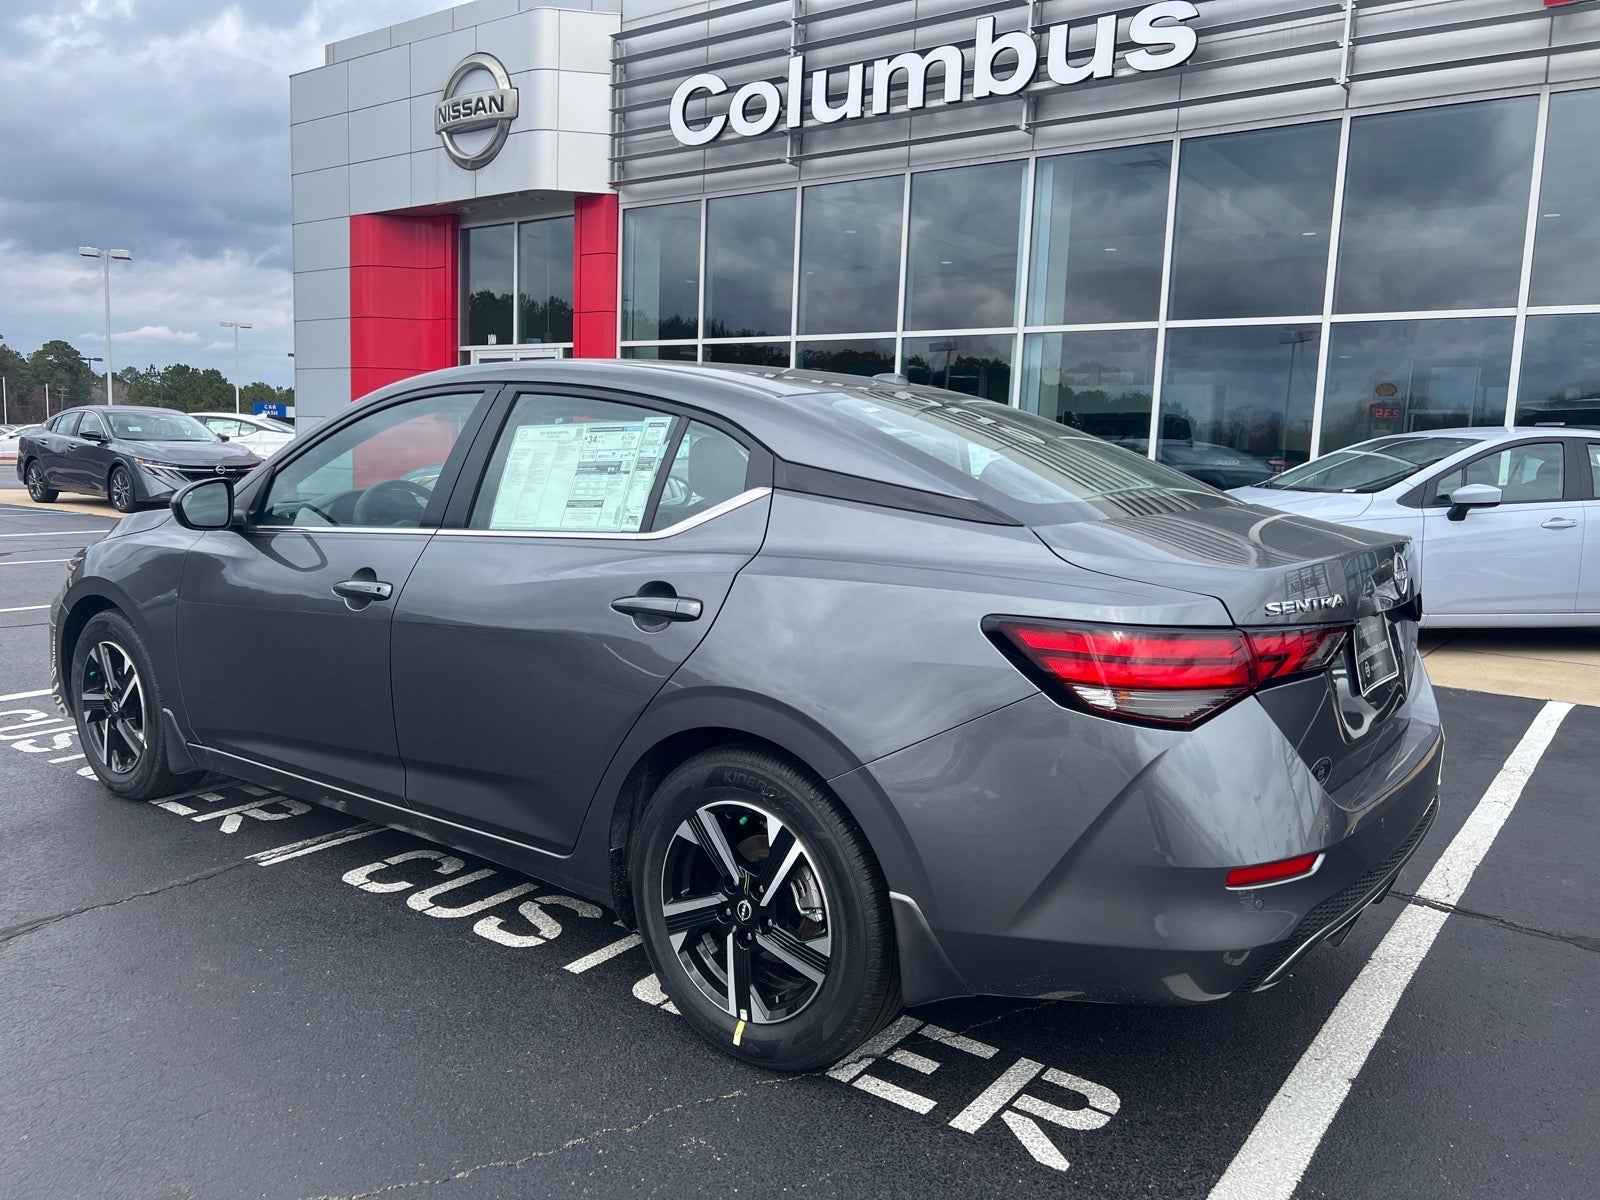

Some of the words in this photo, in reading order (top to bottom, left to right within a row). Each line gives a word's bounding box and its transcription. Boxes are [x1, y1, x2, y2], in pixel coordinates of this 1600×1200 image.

[669, 1, 1199, 146] Columbus
[438, 95, 504, 125] NISSAN
[1265, 594, 1344, 617] SENTRA
